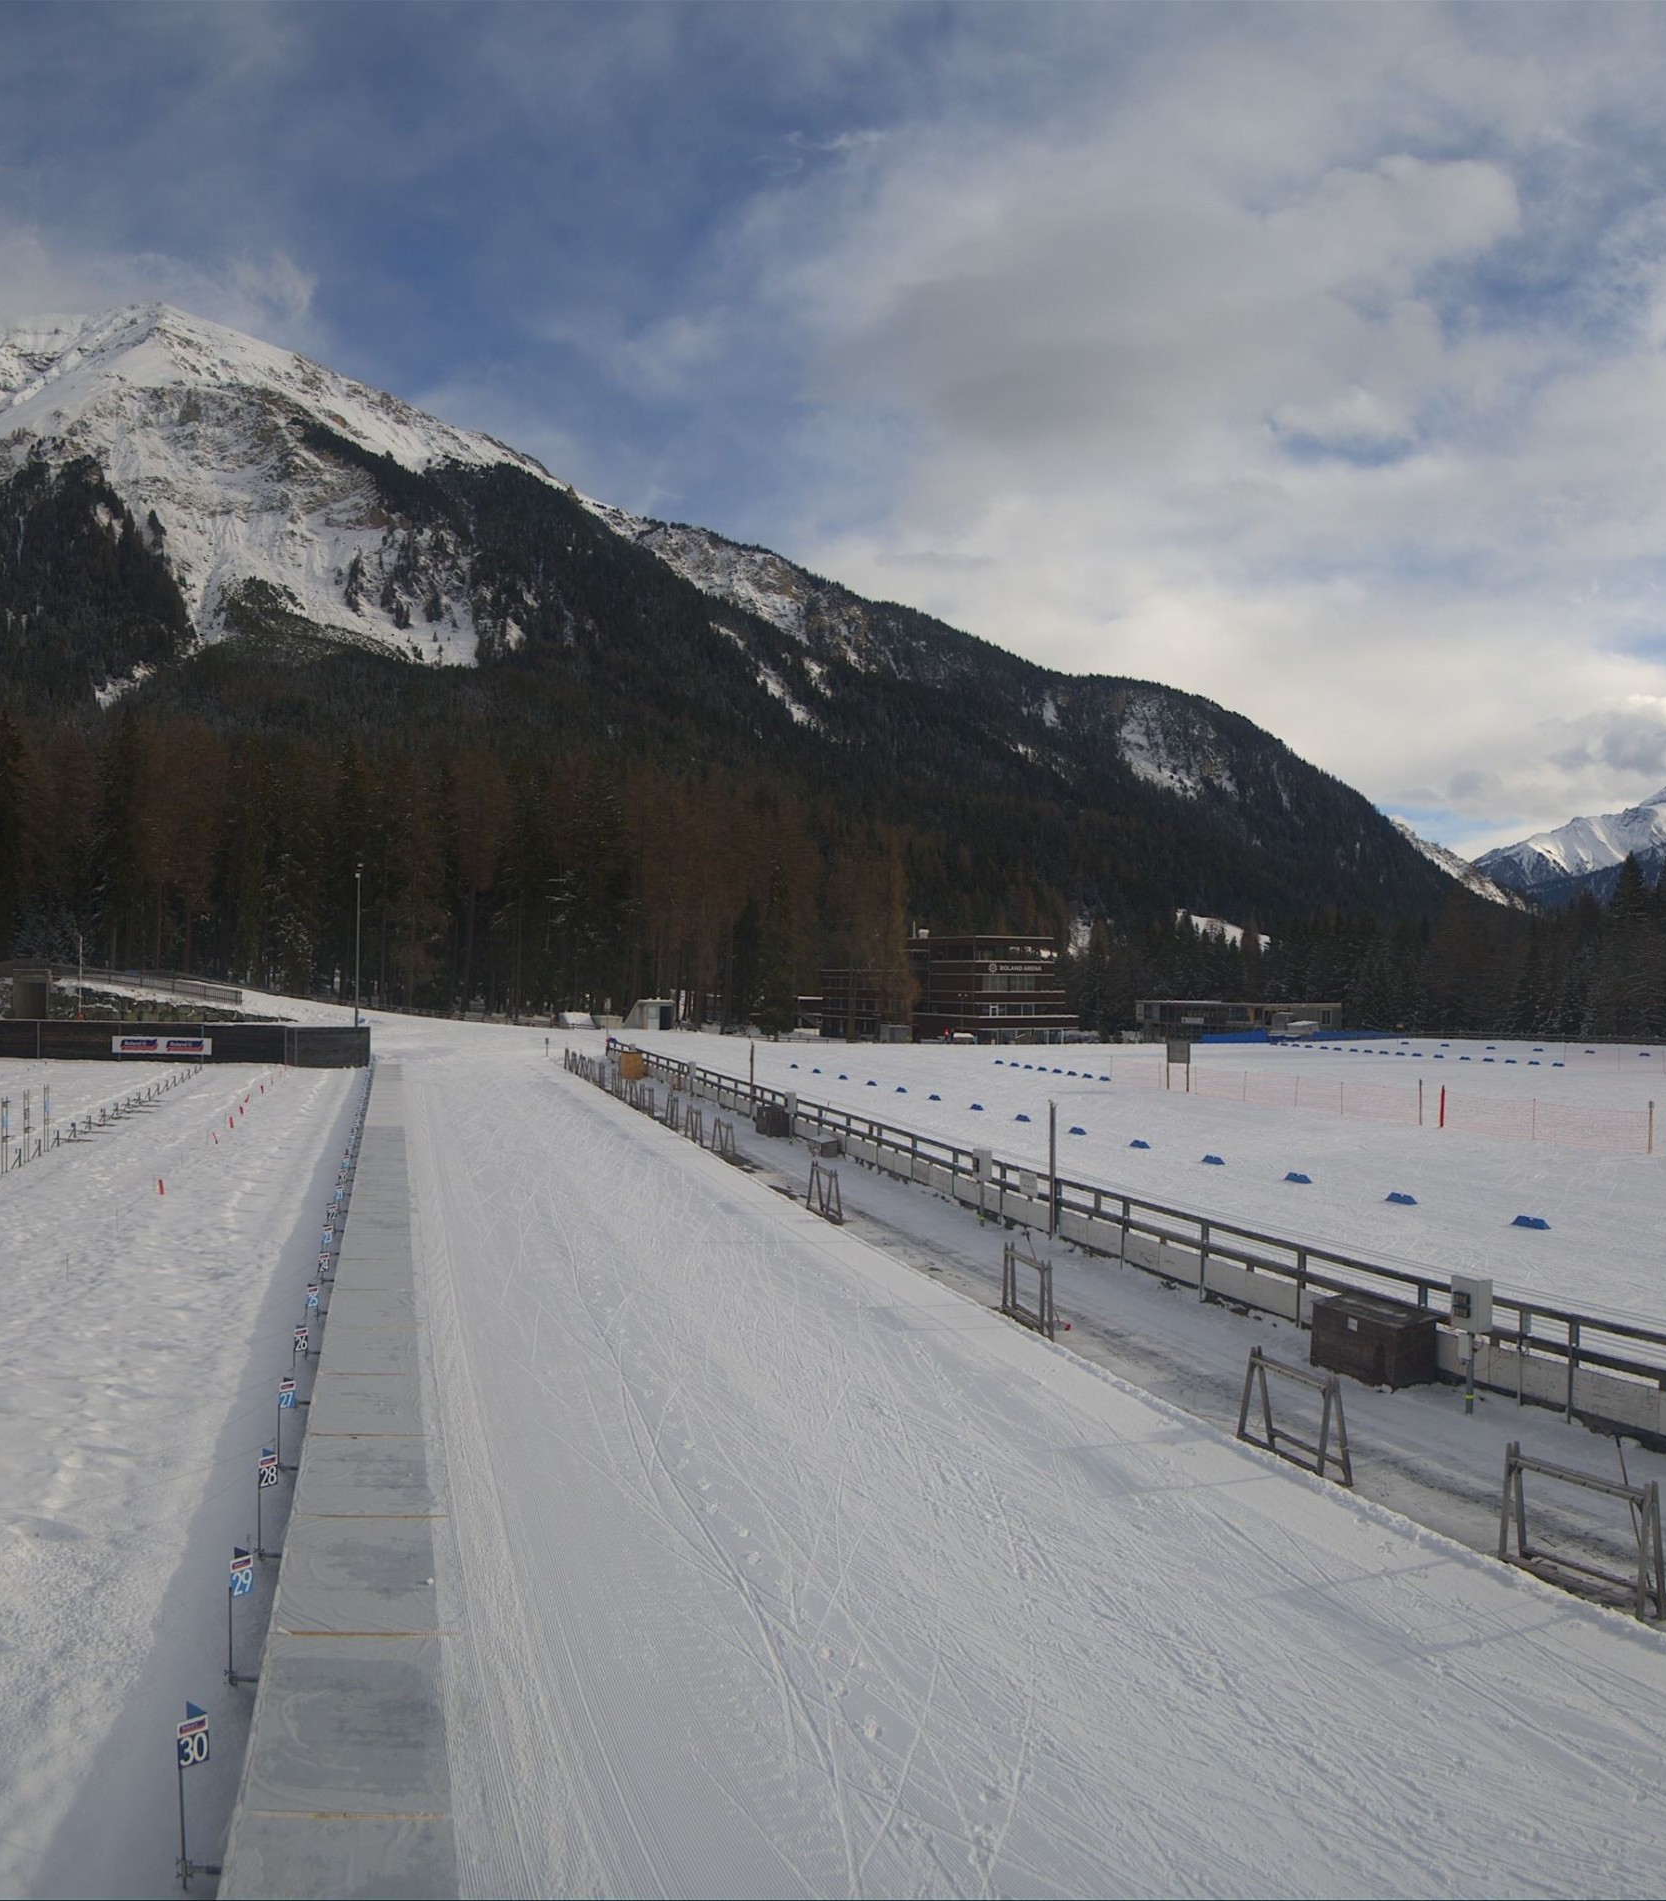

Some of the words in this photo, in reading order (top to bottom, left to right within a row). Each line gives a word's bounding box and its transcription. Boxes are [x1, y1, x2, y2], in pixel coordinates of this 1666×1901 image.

[319, 1259, 329, 1272] 24
[307, 1293, 319, 1307] 25
[295, 1336, 308, 1352] 26
[280, 1391, 293, 1409] 27
[259, 1465, 278, 1488] 28
[231, 1569, 254, 1597] 29
[180, 1731, 208, 1766] 30
